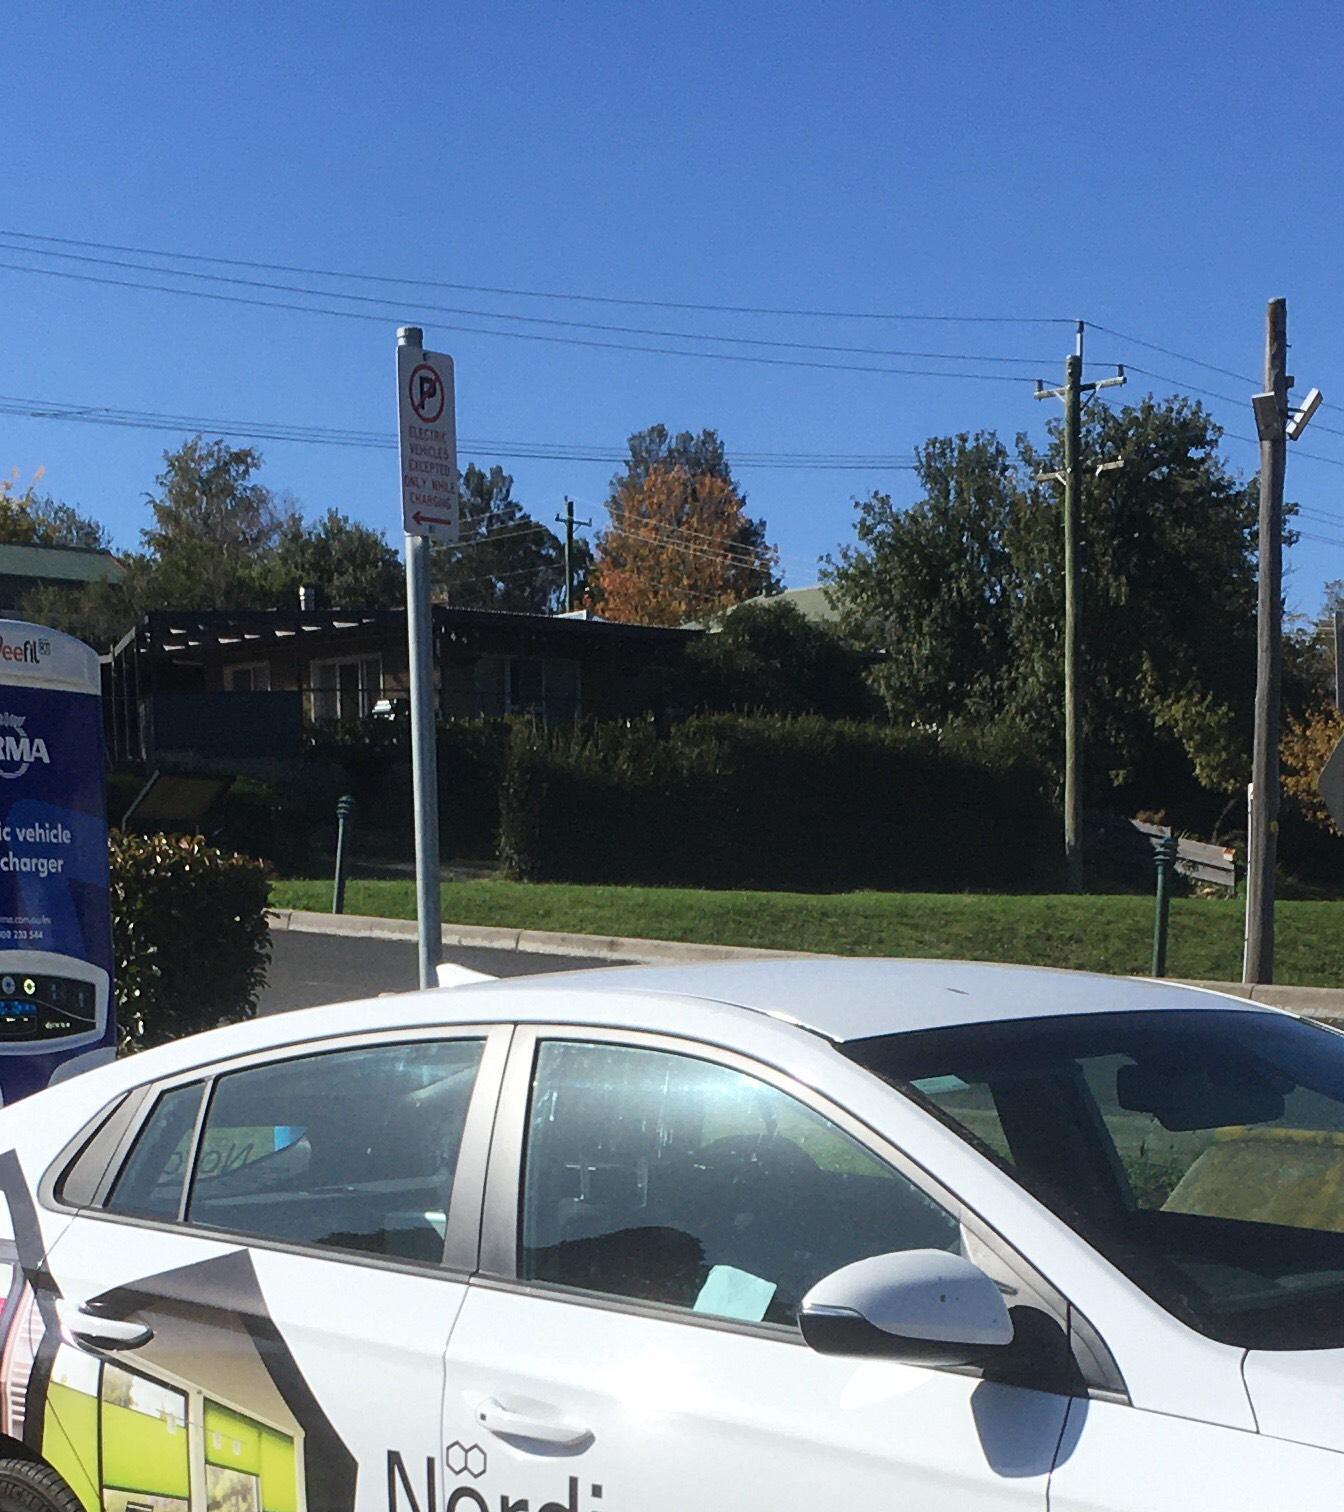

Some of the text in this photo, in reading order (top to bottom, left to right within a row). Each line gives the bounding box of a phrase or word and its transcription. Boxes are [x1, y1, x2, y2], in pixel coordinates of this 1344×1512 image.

[419, 375, 437, 411] P
[16, 822, 72, 844] vehicle
[0, 851, 65, 878] charger
